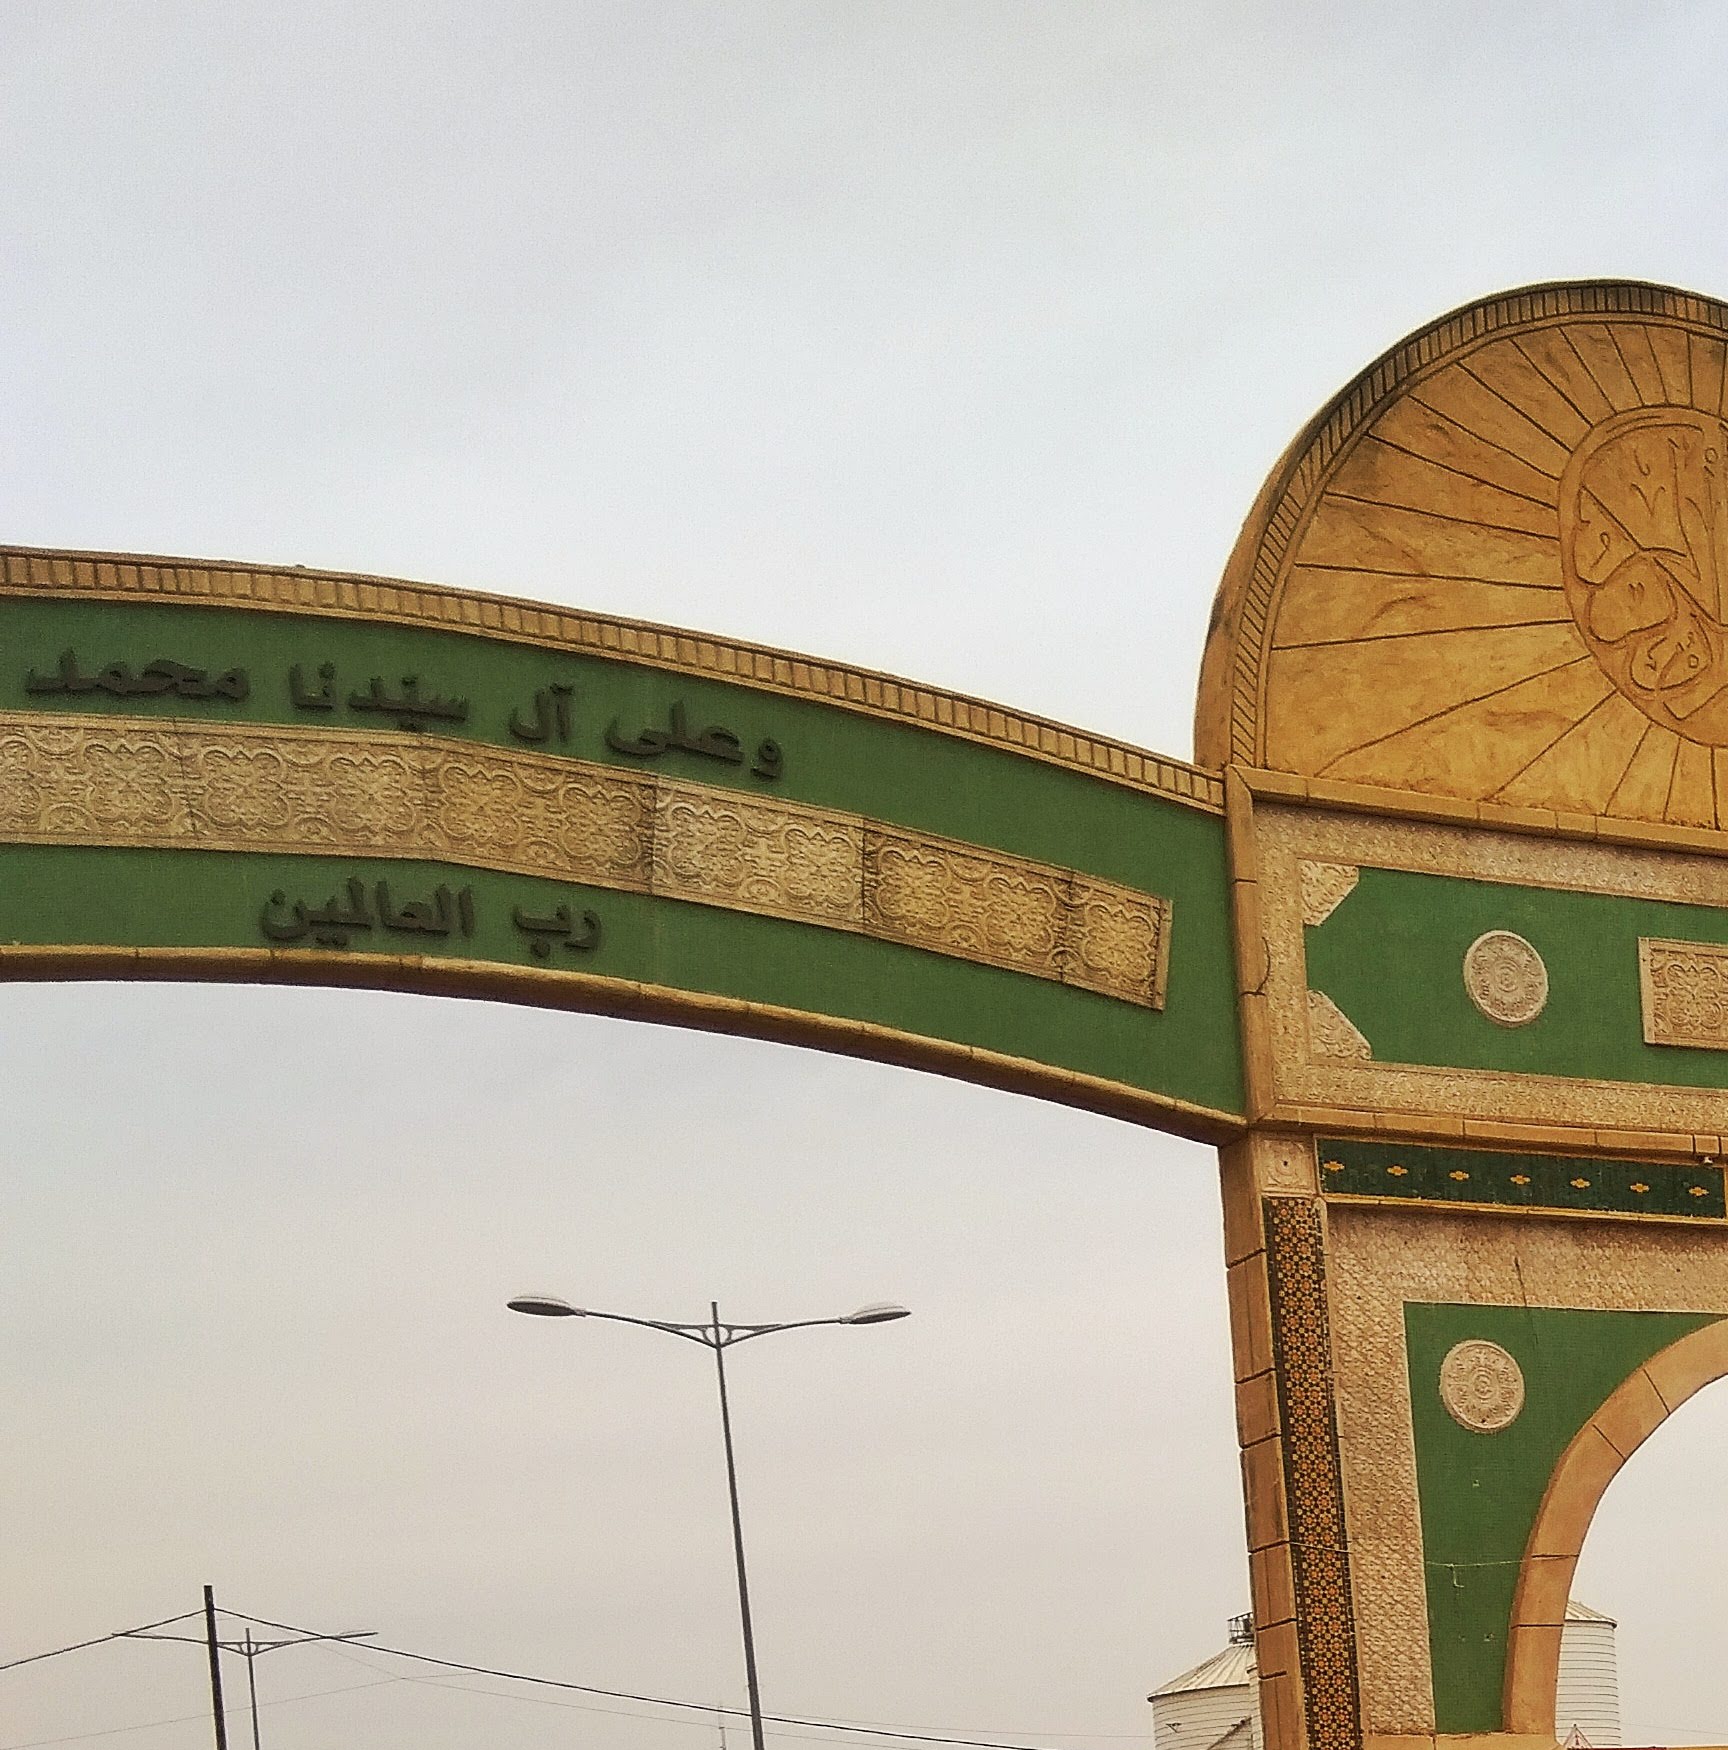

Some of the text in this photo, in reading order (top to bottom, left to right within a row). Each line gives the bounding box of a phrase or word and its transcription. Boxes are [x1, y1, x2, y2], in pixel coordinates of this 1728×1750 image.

[24, 648, 250, 701] محمد
[509, 683, 574, 744] آل
[603, 700, 783, 781] وعلى
[512, 899, 602, 958] رب
